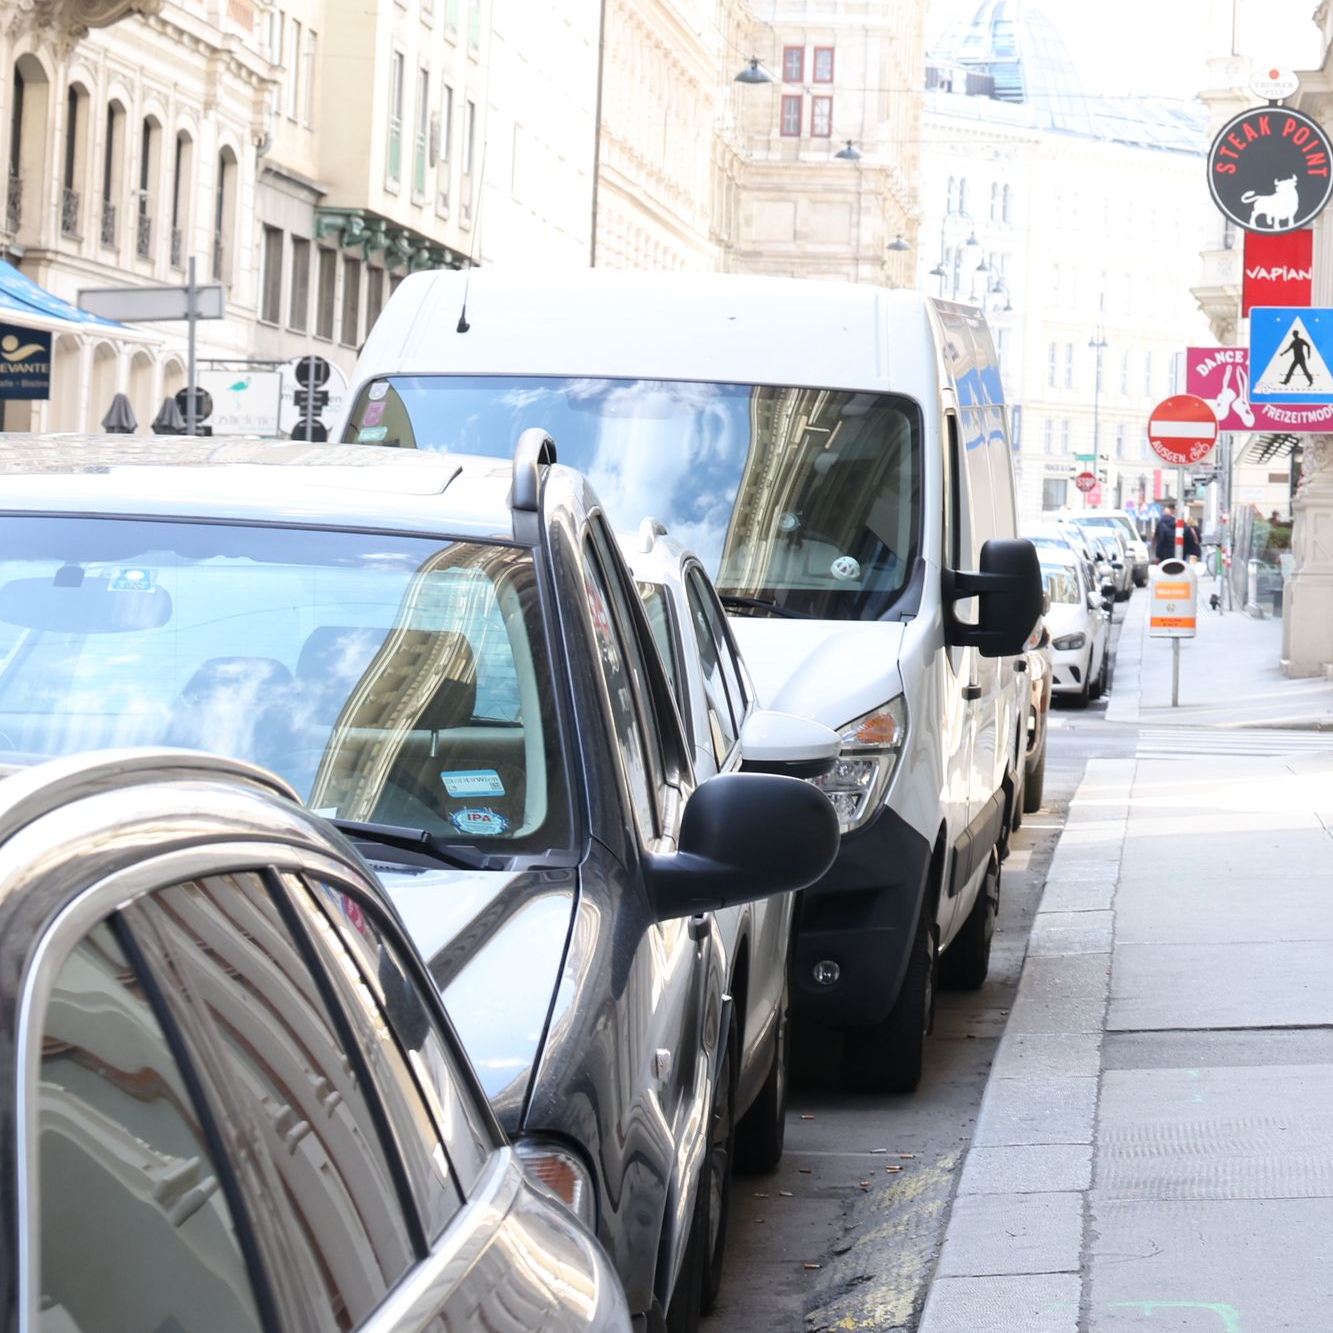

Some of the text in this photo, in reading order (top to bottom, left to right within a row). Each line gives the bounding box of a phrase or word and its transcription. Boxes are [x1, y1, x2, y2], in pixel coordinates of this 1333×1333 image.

[1215, 115, 1328, 177] STEAK POINT
[1195, 350, 1244, 378] DANCE
[467, 813, 491, 822] IPA
